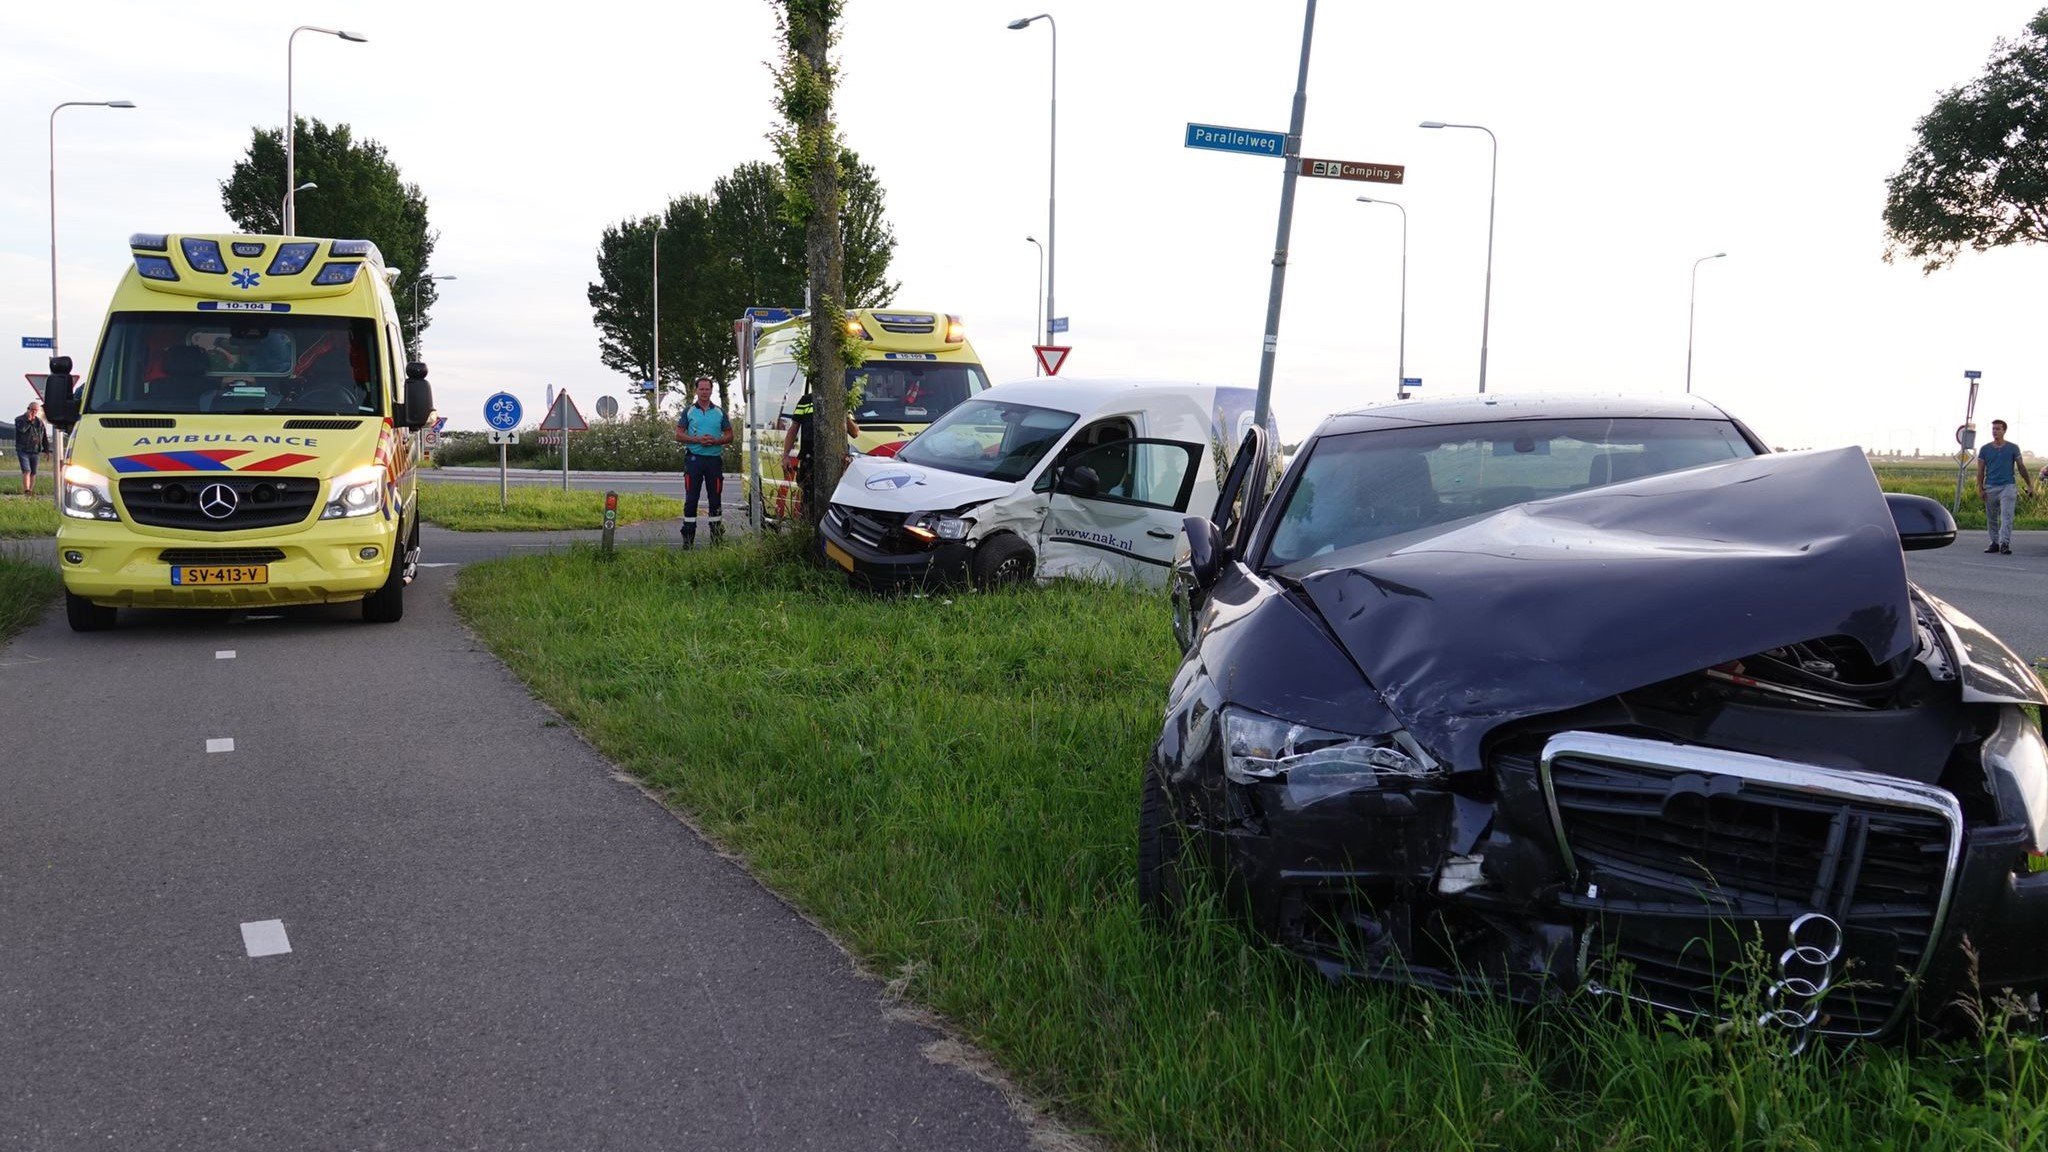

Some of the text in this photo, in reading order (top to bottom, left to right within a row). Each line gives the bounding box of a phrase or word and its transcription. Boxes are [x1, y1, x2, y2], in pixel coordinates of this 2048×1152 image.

[1195, 129, 1276, 151] Parallelweg
[1342, 164, 1391, 180] Camping
[133, 434, 318, 447] AMBULANCE
[1055, 527, 1133, 551] www.nak.nl
[188, 568, 258, 582] SV-413-V
